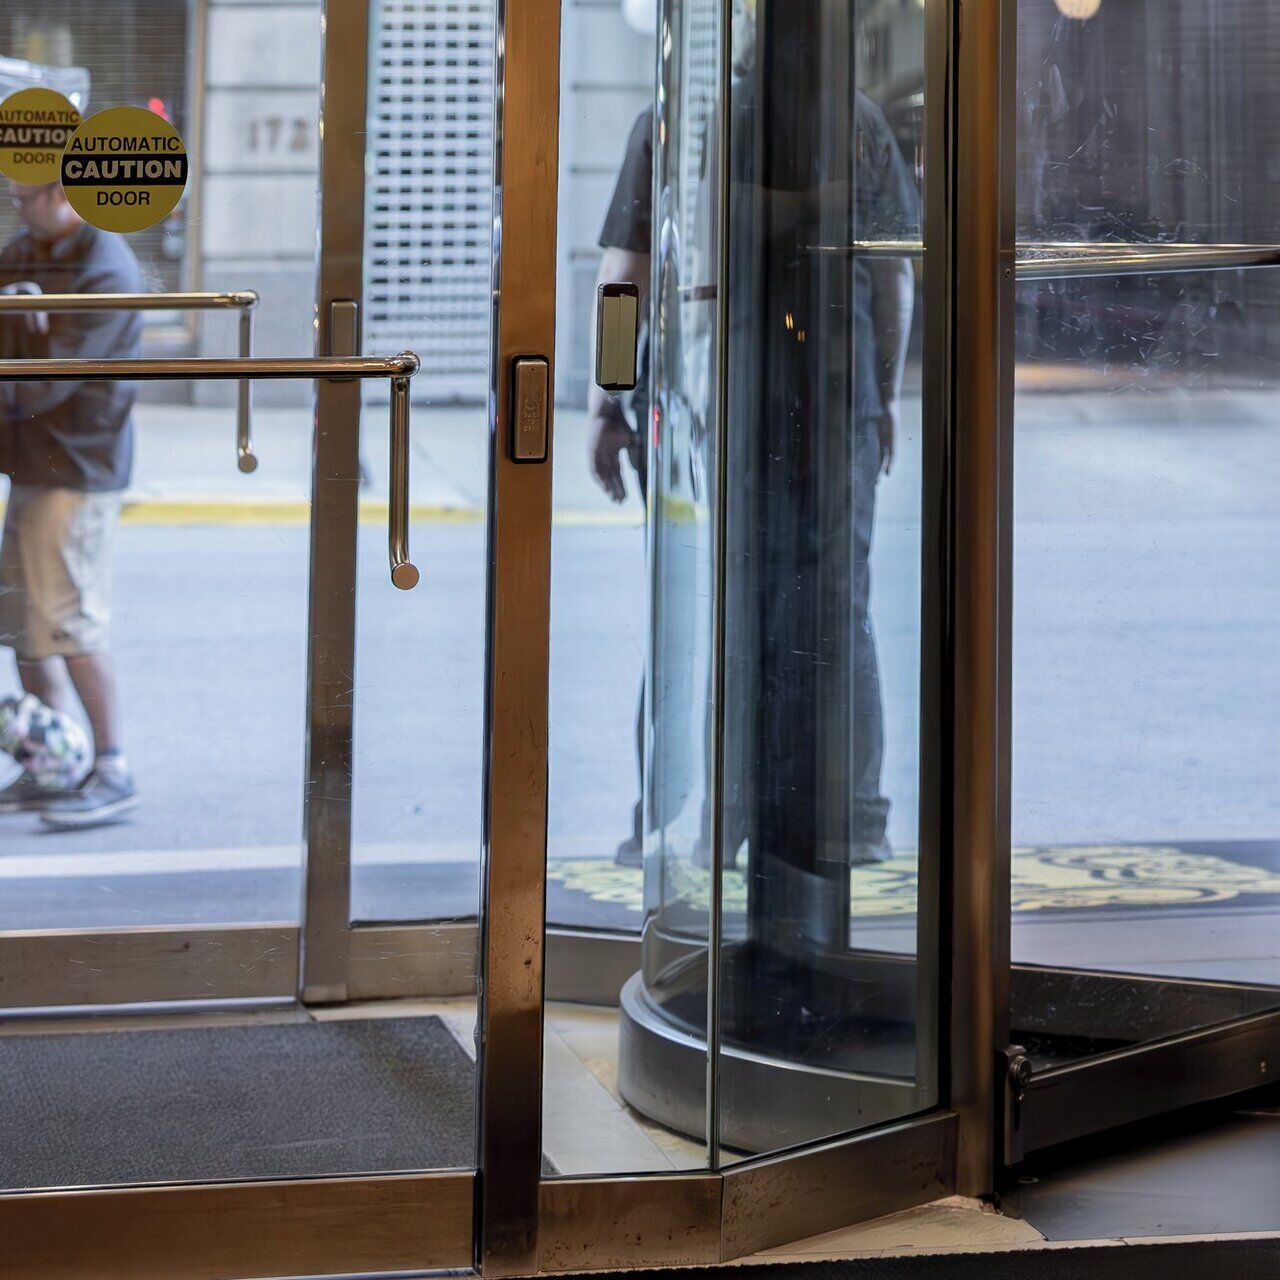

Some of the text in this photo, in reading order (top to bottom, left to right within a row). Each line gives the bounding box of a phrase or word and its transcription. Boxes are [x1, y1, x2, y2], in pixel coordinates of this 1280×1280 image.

[0, 127, 75, 144] AUTIO
[71, 136, 180, 151] AUTOMATIC
[13, 152, 56, 164] DOOR
[65, 160, 182, 179] CAUTION
[97, 191, 150, 205] DOOR
